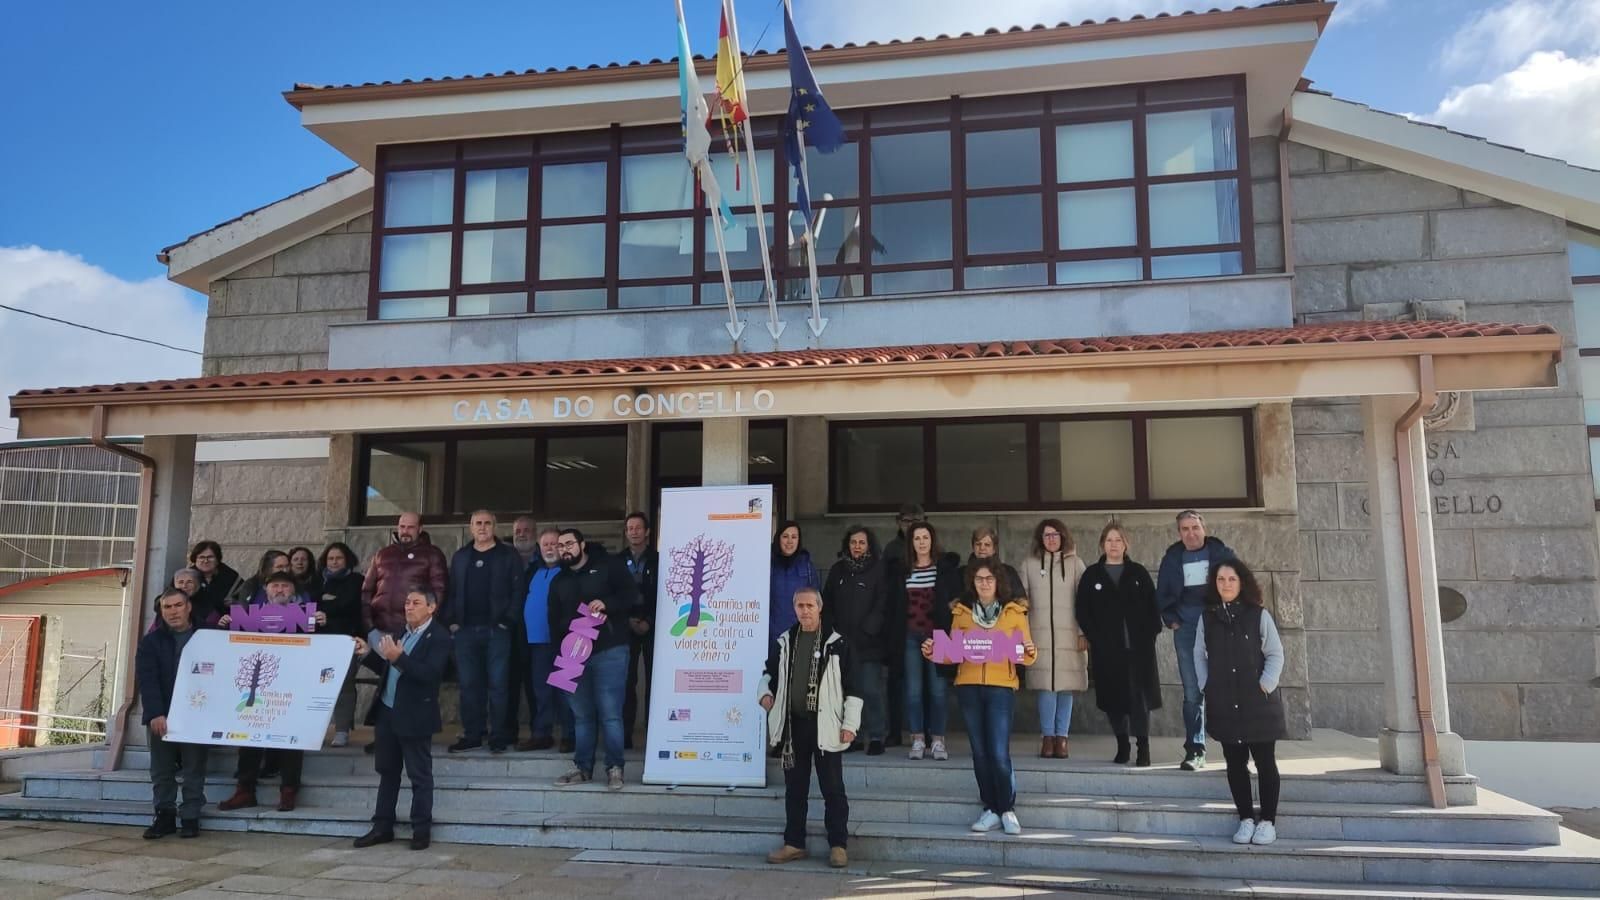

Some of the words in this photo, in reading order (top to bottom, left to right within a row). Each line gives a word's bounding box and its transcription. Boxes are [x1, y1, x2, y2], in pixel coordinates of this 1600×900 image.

[453, 398, 534, 421] CASA
[553, 395, 594, 418] DO
[613, 388, 775, 416] CONCELLO
[1427, 441, 1460, 460] SA
[715, 611, 760, 626] igualdade
[674, 638, 718, 650] violencia
[724, 639, 737, 650] de
